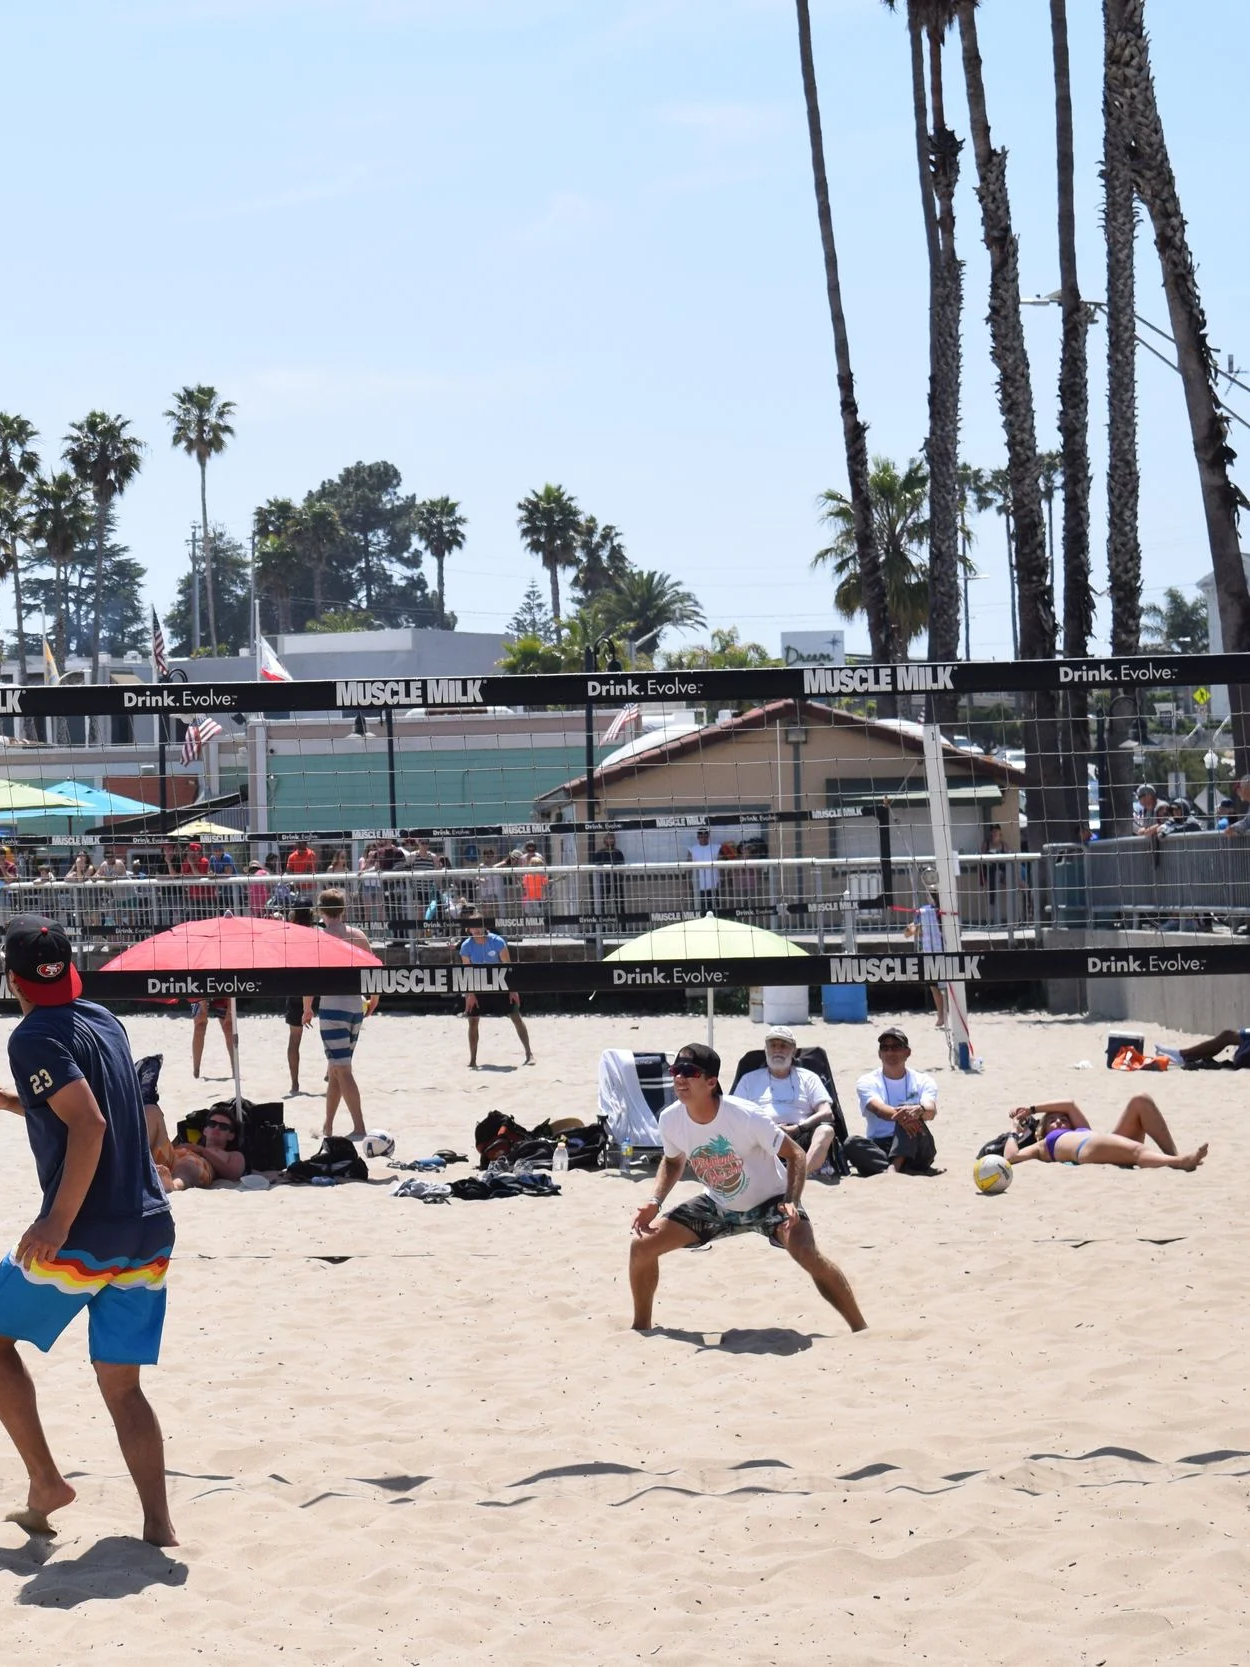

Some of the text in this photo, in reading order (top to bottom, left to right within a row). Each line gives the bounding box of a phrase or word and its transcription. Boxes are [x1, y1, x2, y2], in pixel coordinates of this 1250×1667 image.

[784, 645, 834, 666] Dream
[802, 667, 892, 693] MUSCLE
[1060, 665, 1117, 682] Drink.
[336, 680, 422, 706] MUSCLE
[588, 679, 644, 696] Drink.
[124, 690, 175, 707] Drink.
[830, 958, 919, 982] MUSCLE
[1088, 956, 1145, 972] Drink.
[148, 977, 203, 993] Drink.
[361, 969, 447, 993] MUSCLE
[614, 967, 670, 984] Drink.
[30, 1068, 54, 1095] 23
